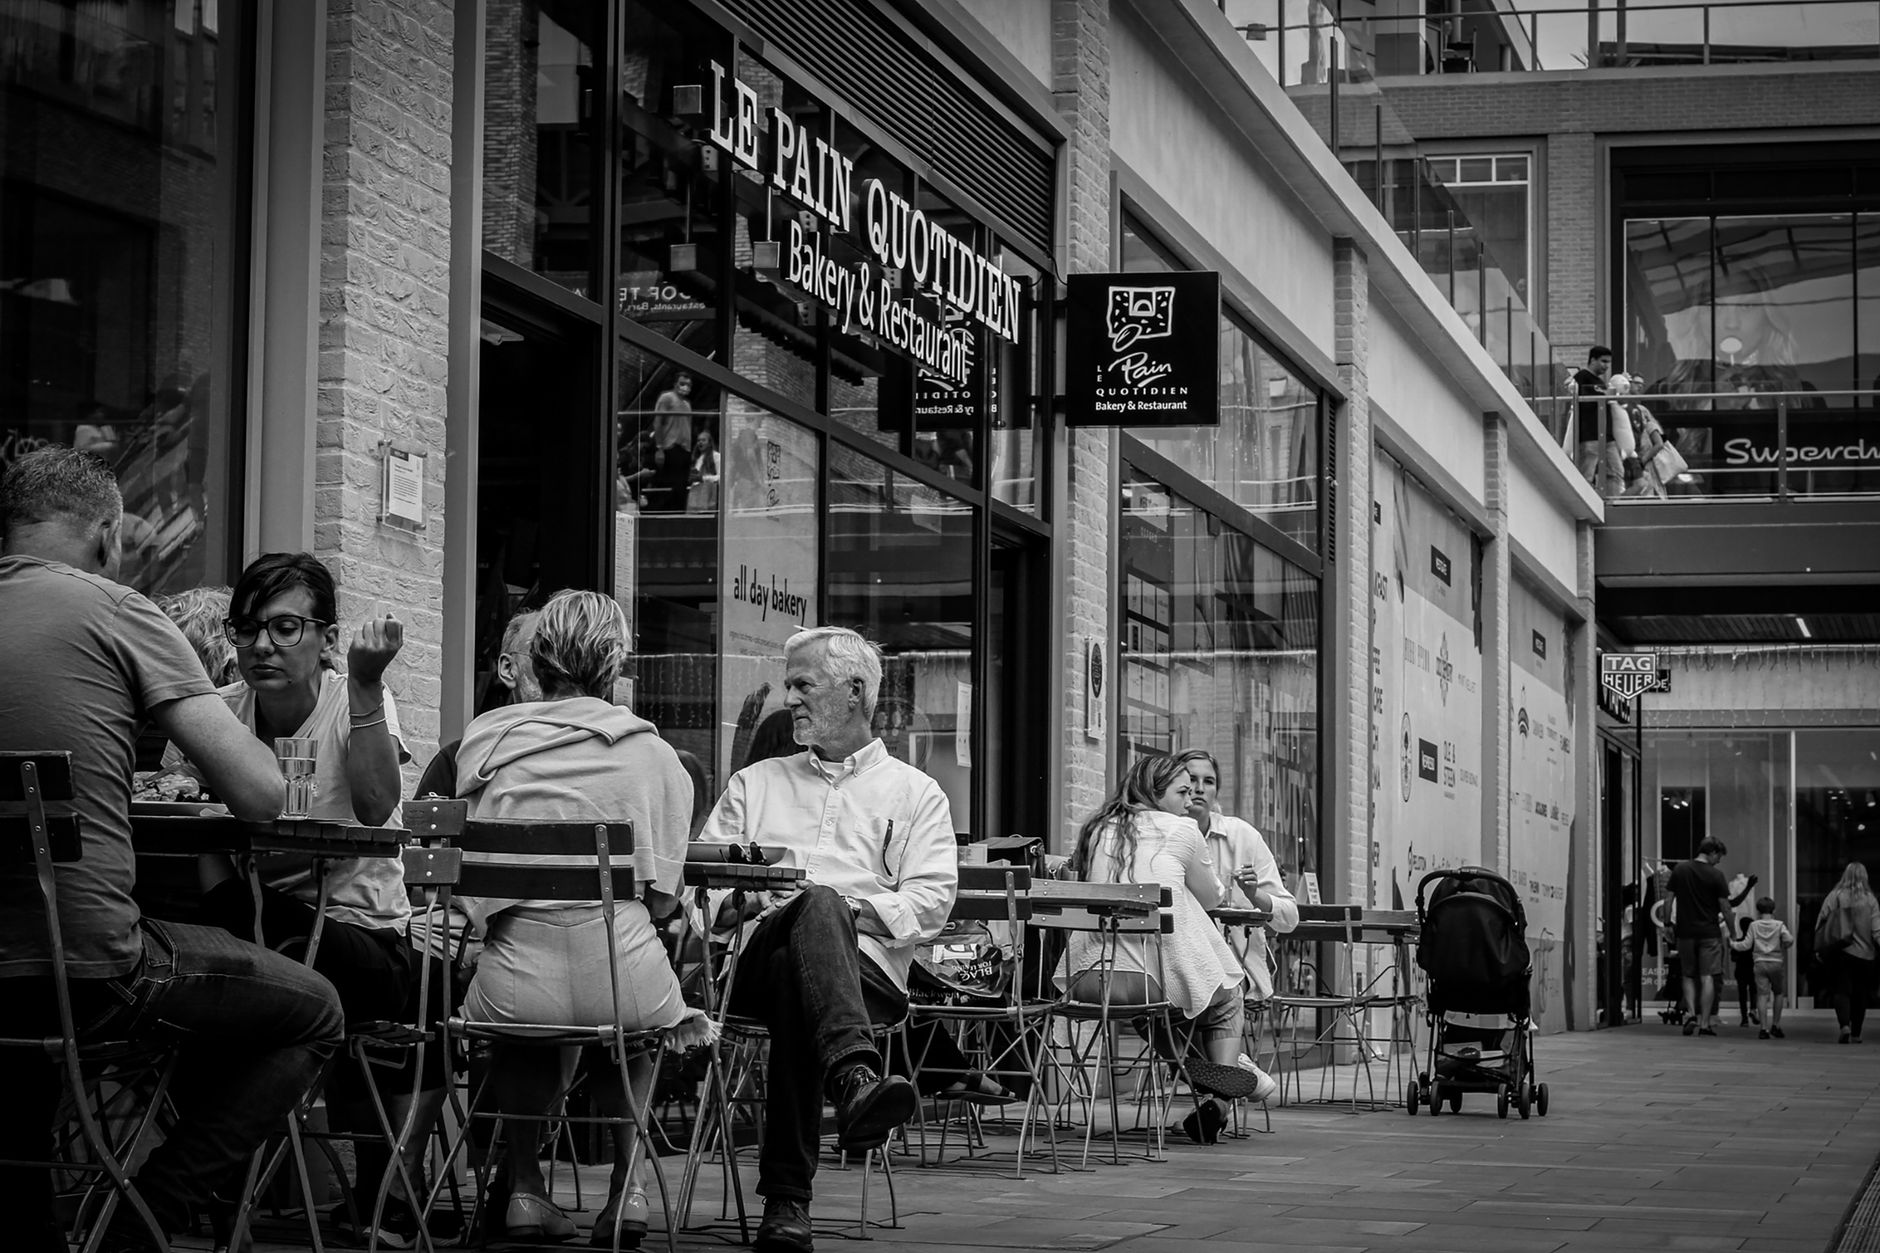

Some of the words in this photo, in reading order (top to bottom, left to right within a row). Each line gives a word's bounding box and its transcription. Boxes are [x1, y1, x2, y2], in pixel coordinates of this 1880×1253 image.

[711, 59, 757, 170] LE
[773, 107, 853, 232] PAIN
[868, 178, 1021, 344] QUOTIDIEN
[790, 219, 855, 334] Bakery
[858, 262, 875, 331] &
[880, 278, 968, 385] Restaurant
[1108, 352, 1172, 385] Pain
[1096, 387, 1188, 397] QUOTIDIEN
[1095, 401, 1126, 413] Bakery
[1127, 401, 1137, 411] &
[1138, 400, 1188, 411] Restaurant
[734, 564, 747, 602] all
[750, 568, 769, 622] day
[772, 574, 807, 632] bakery
[1606, 656, 1651, 671] TAG
[1604, 674, 1653, 695] HEUER
